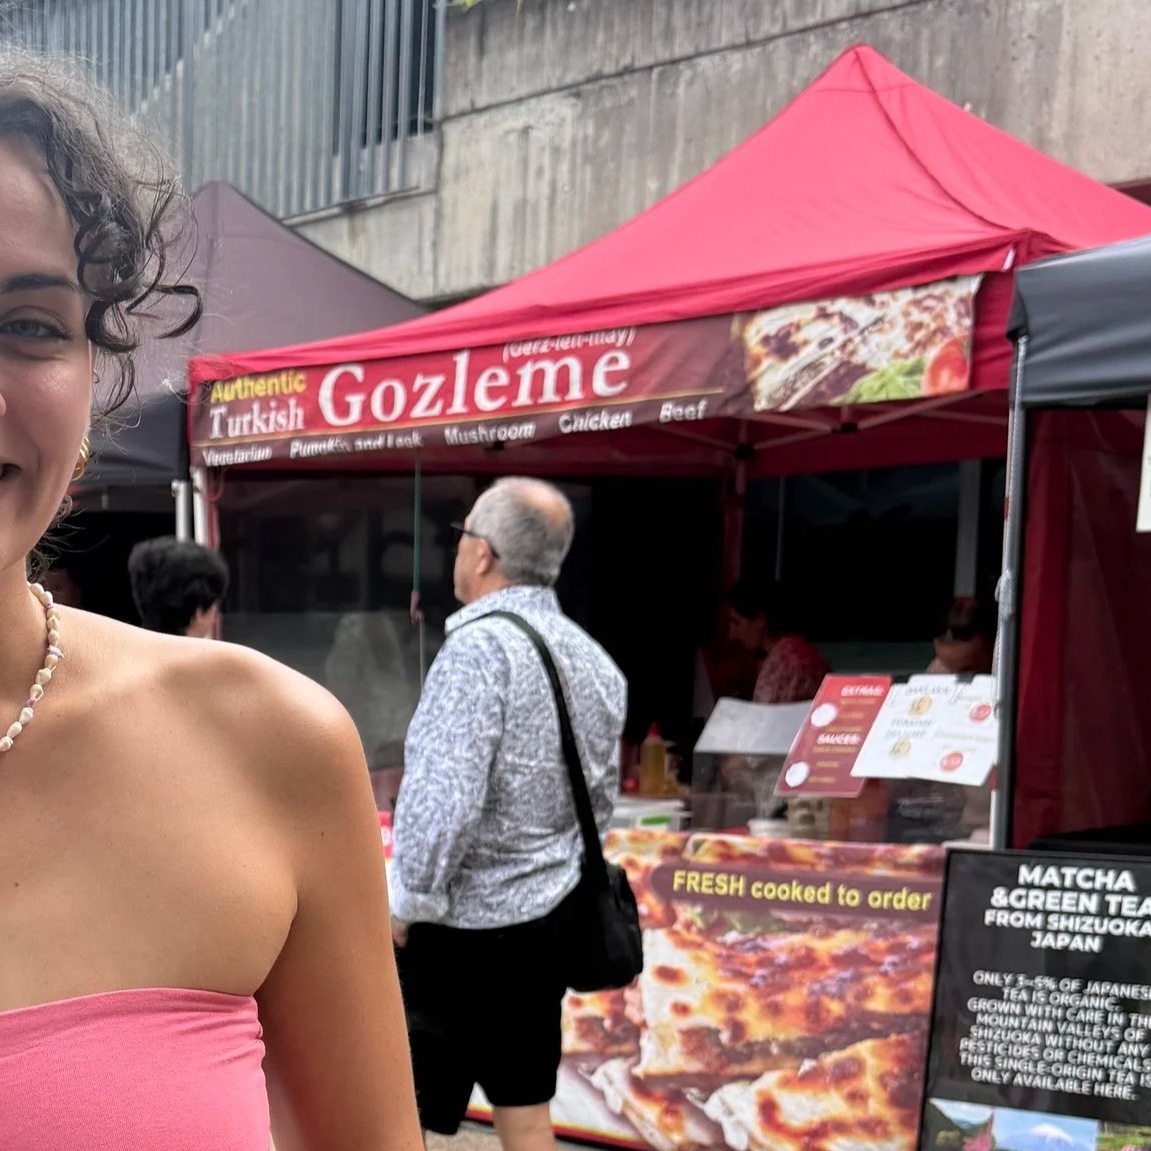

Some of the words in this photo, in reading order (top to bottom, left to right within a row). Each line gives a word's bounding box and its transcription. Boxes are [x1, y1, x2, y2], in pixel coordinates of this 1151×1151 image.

[210, 368, 307, 403] Authentic
[319, 350, 631, 427] Gozleme
[202, 446, 272, 467] Vegetarian
[355, 434, 382, 451] and
[444, 421, 536, 445] Mushroom
[559, 409, 632, 434] Chicken
[660, 399, 707, 423] Beef
[209, 397, 305, 439] Turkish
[673, 869, 745, 898] FRESH
[751, 872, 830, 905] cooked
[837, 884, 860, 906] to
[867, 888, 932, 912] order
[1018, 864, 1136, 892] MATCHA
[990, 886, 1098, 914] &GREEN
[1105, 894, 1151, 918] TEA
[984, 909, 1045, 930] FROM
[1047, 912, 1151, 938] SHIZUOKA
[1030, 930, 1103, 953] JAPAN
[973, 970, 1013, 987] ONLY
[1059, 978, 1084, 993] OF
[1085, 980, 1151, 1000] JAPANES
[1002, 986, 1029, 1002] TEA
[1031, 989, 1048, 1005] IS
[967, 997, 1021, 1015] GROWN
[1025, 1001, 1062, 1020] WITH
[1066, 1007, 1106, 1024] CARE
[1107, 1011, 1126, 1026] IN
[970, 1024, 1041, 1046] SHIZUOKA
[1045, 1033, 1116, 1054] WITHOUT
[1117, 1041, 1151, 1058] ANY
[976, 1012, 1053, 1034] MOUNTAIN
[1057, 1020, 1122, 1041] VALLEYS
[1124, 1027, 1146, 1043] OF
[959, 1037, 1041, 1061] PESTICIDES
[1043, 1048, 1066, 1063] OR
[959, 1051, 992, 1069] THIS
[1107, 1067, 1139, 1086] TEA
[971, 1066, 1014, 1086] ONLY
[1013, 1072, 1093, 1096] AVAILABLE
